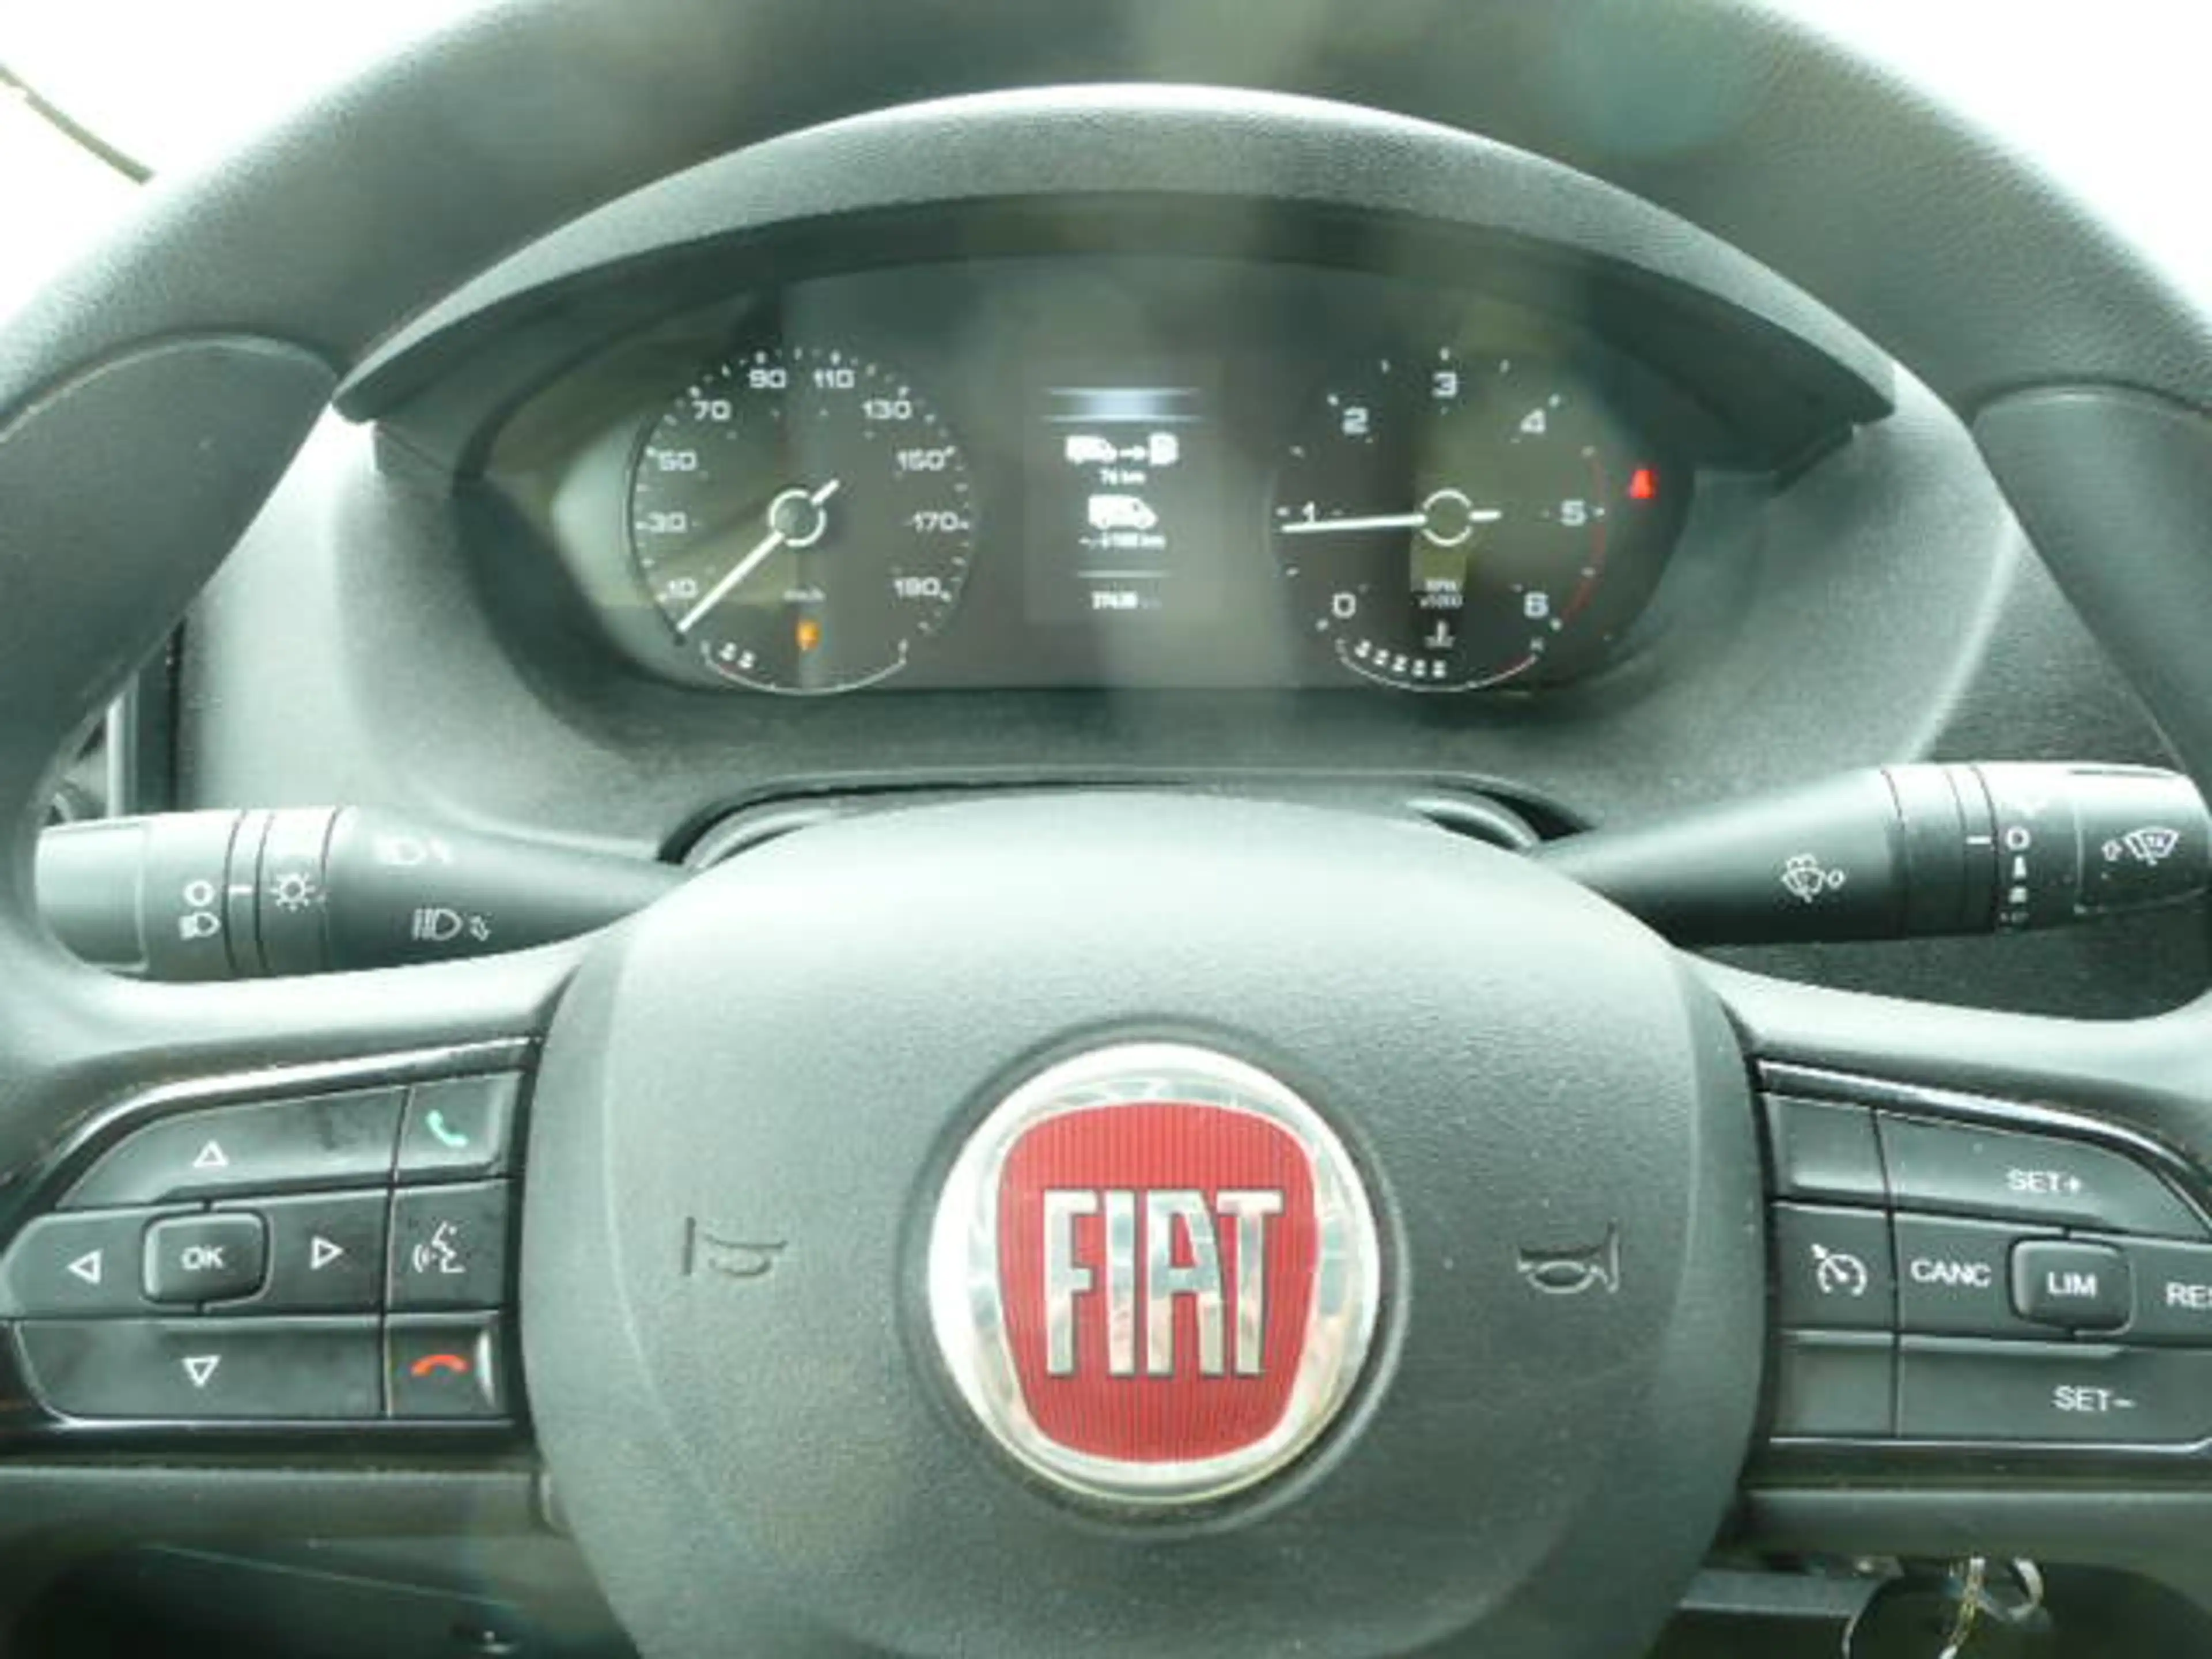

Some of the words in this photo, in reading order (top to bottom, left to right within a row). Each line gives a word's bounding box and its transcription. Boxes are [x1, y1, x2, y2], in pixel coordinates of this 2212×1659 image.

[749, 368, 787, 389] 90
[813, 368, 855, 389] 110
[1432, 372, 1458, 398] 3
[695, 400, 732, 421] 70
[862, 399, 913, 421] 130
[1343, 407, 1369, 435] 2
[1520, 410, 1546, 434] 4
[658, 449, 698, 471] 50
[912, 512, 960, 533] 170
[1561, 500, 1587, 527] 5
[667, 578, 699, 599] 10
[1331, 592, 1356, 618] 0
[1524, 592, 1550, 618] 6
[181, 1247, 225, 1271] OK
[1044, 1189, 1285, 1377] FIAT
[1910, 1258, 1991, 1288] CANC
[2047, 1271, 2097, 1297] LIM
